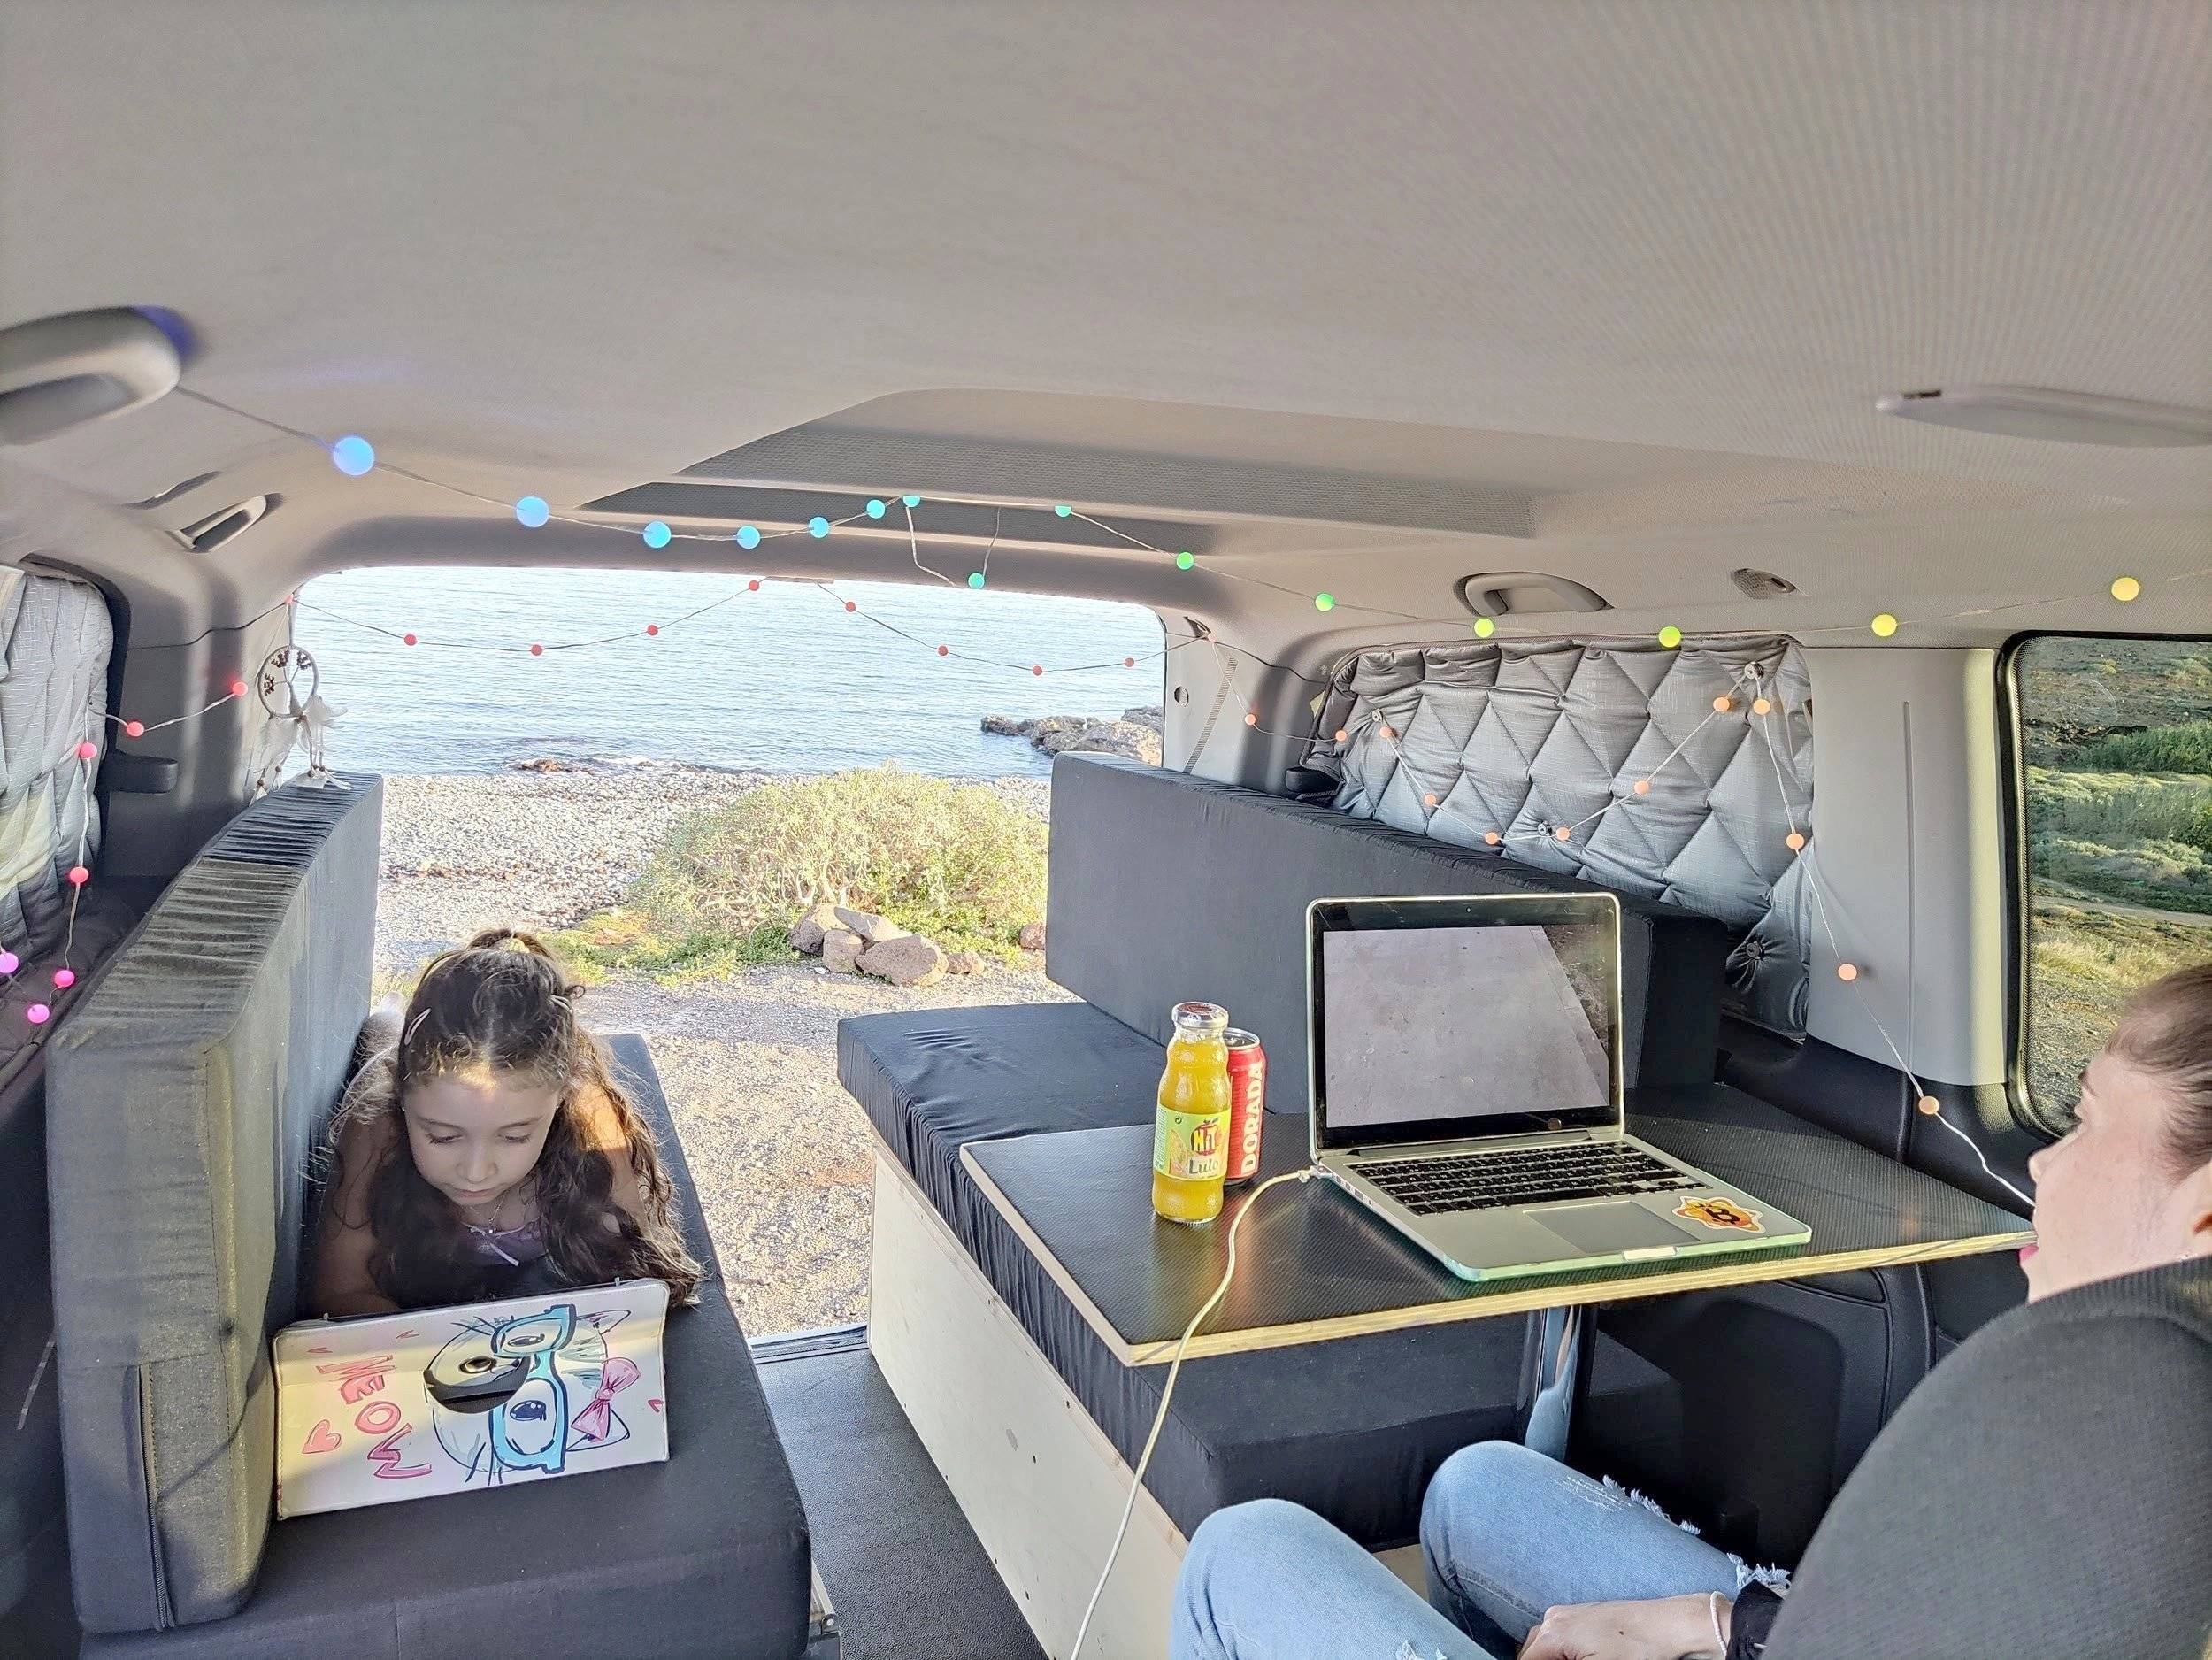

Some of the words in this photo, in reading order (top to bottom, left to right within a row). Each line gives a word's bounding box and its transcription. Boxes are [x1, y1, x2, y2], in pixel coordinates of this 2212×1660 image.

[1188, 1158, 1219, 1175] Lulo
[1242, 1063, 1262, 1174] DORADA
[316, 1355, 433, 1479] MEOW
